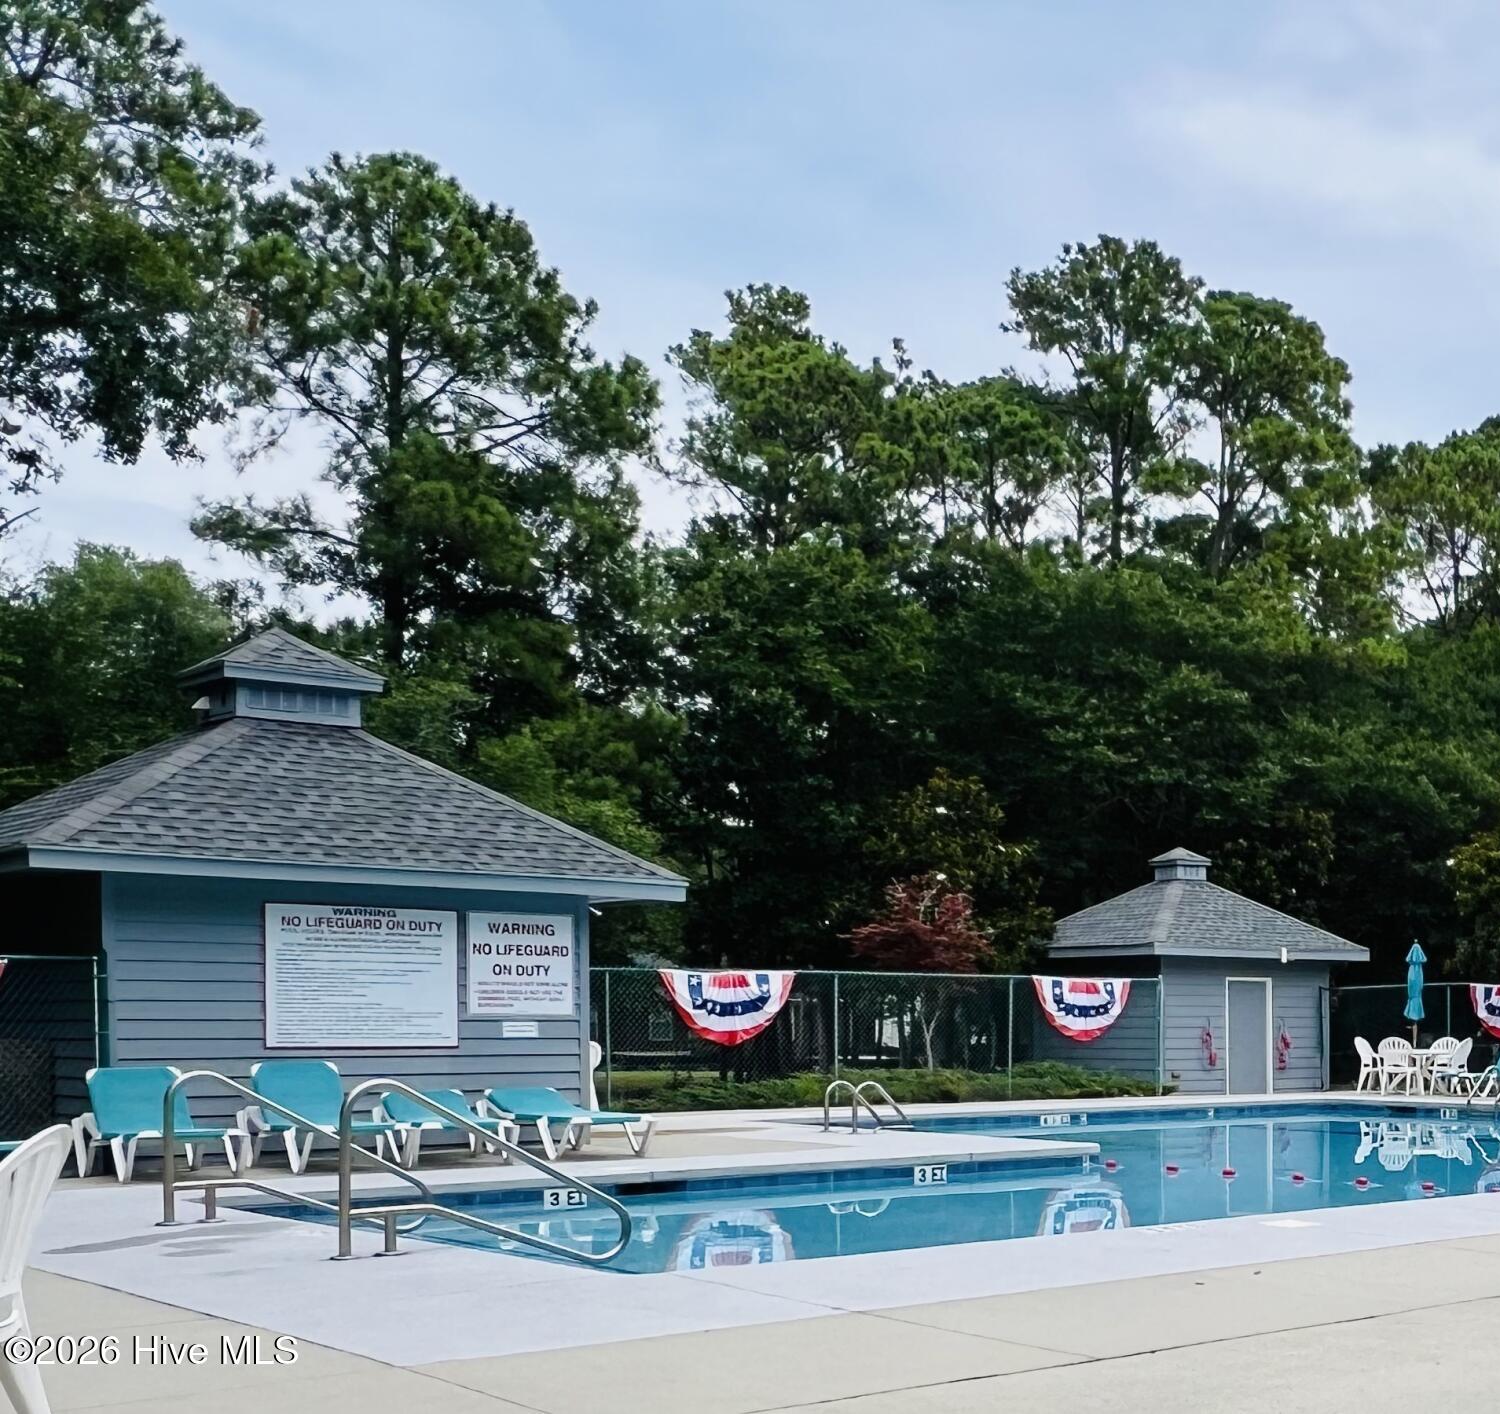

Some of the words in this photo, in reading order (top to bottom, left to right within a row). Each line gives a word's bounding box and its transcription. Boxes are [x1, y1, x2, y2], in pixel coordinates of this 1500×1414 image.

[331, 907, 397, 918] WARNING
[281, 916, 301, 928] NO
[306, 917, 382, 930] LIFEGUARD
[386, 919, 405, 931] ON
[409, 921, 443, 933] DUTY
[488, 922, 555, 936] WARNING
[472, 943, 492, 955] NO
[496, 944, 569, 957] LIFEGUARD
[493, 963, 512, 976] ON
[516, 964, 550, 977] DUTY
[918, 1168, 927, 1183] 3
[550, 1192, 560, 1206] 3
